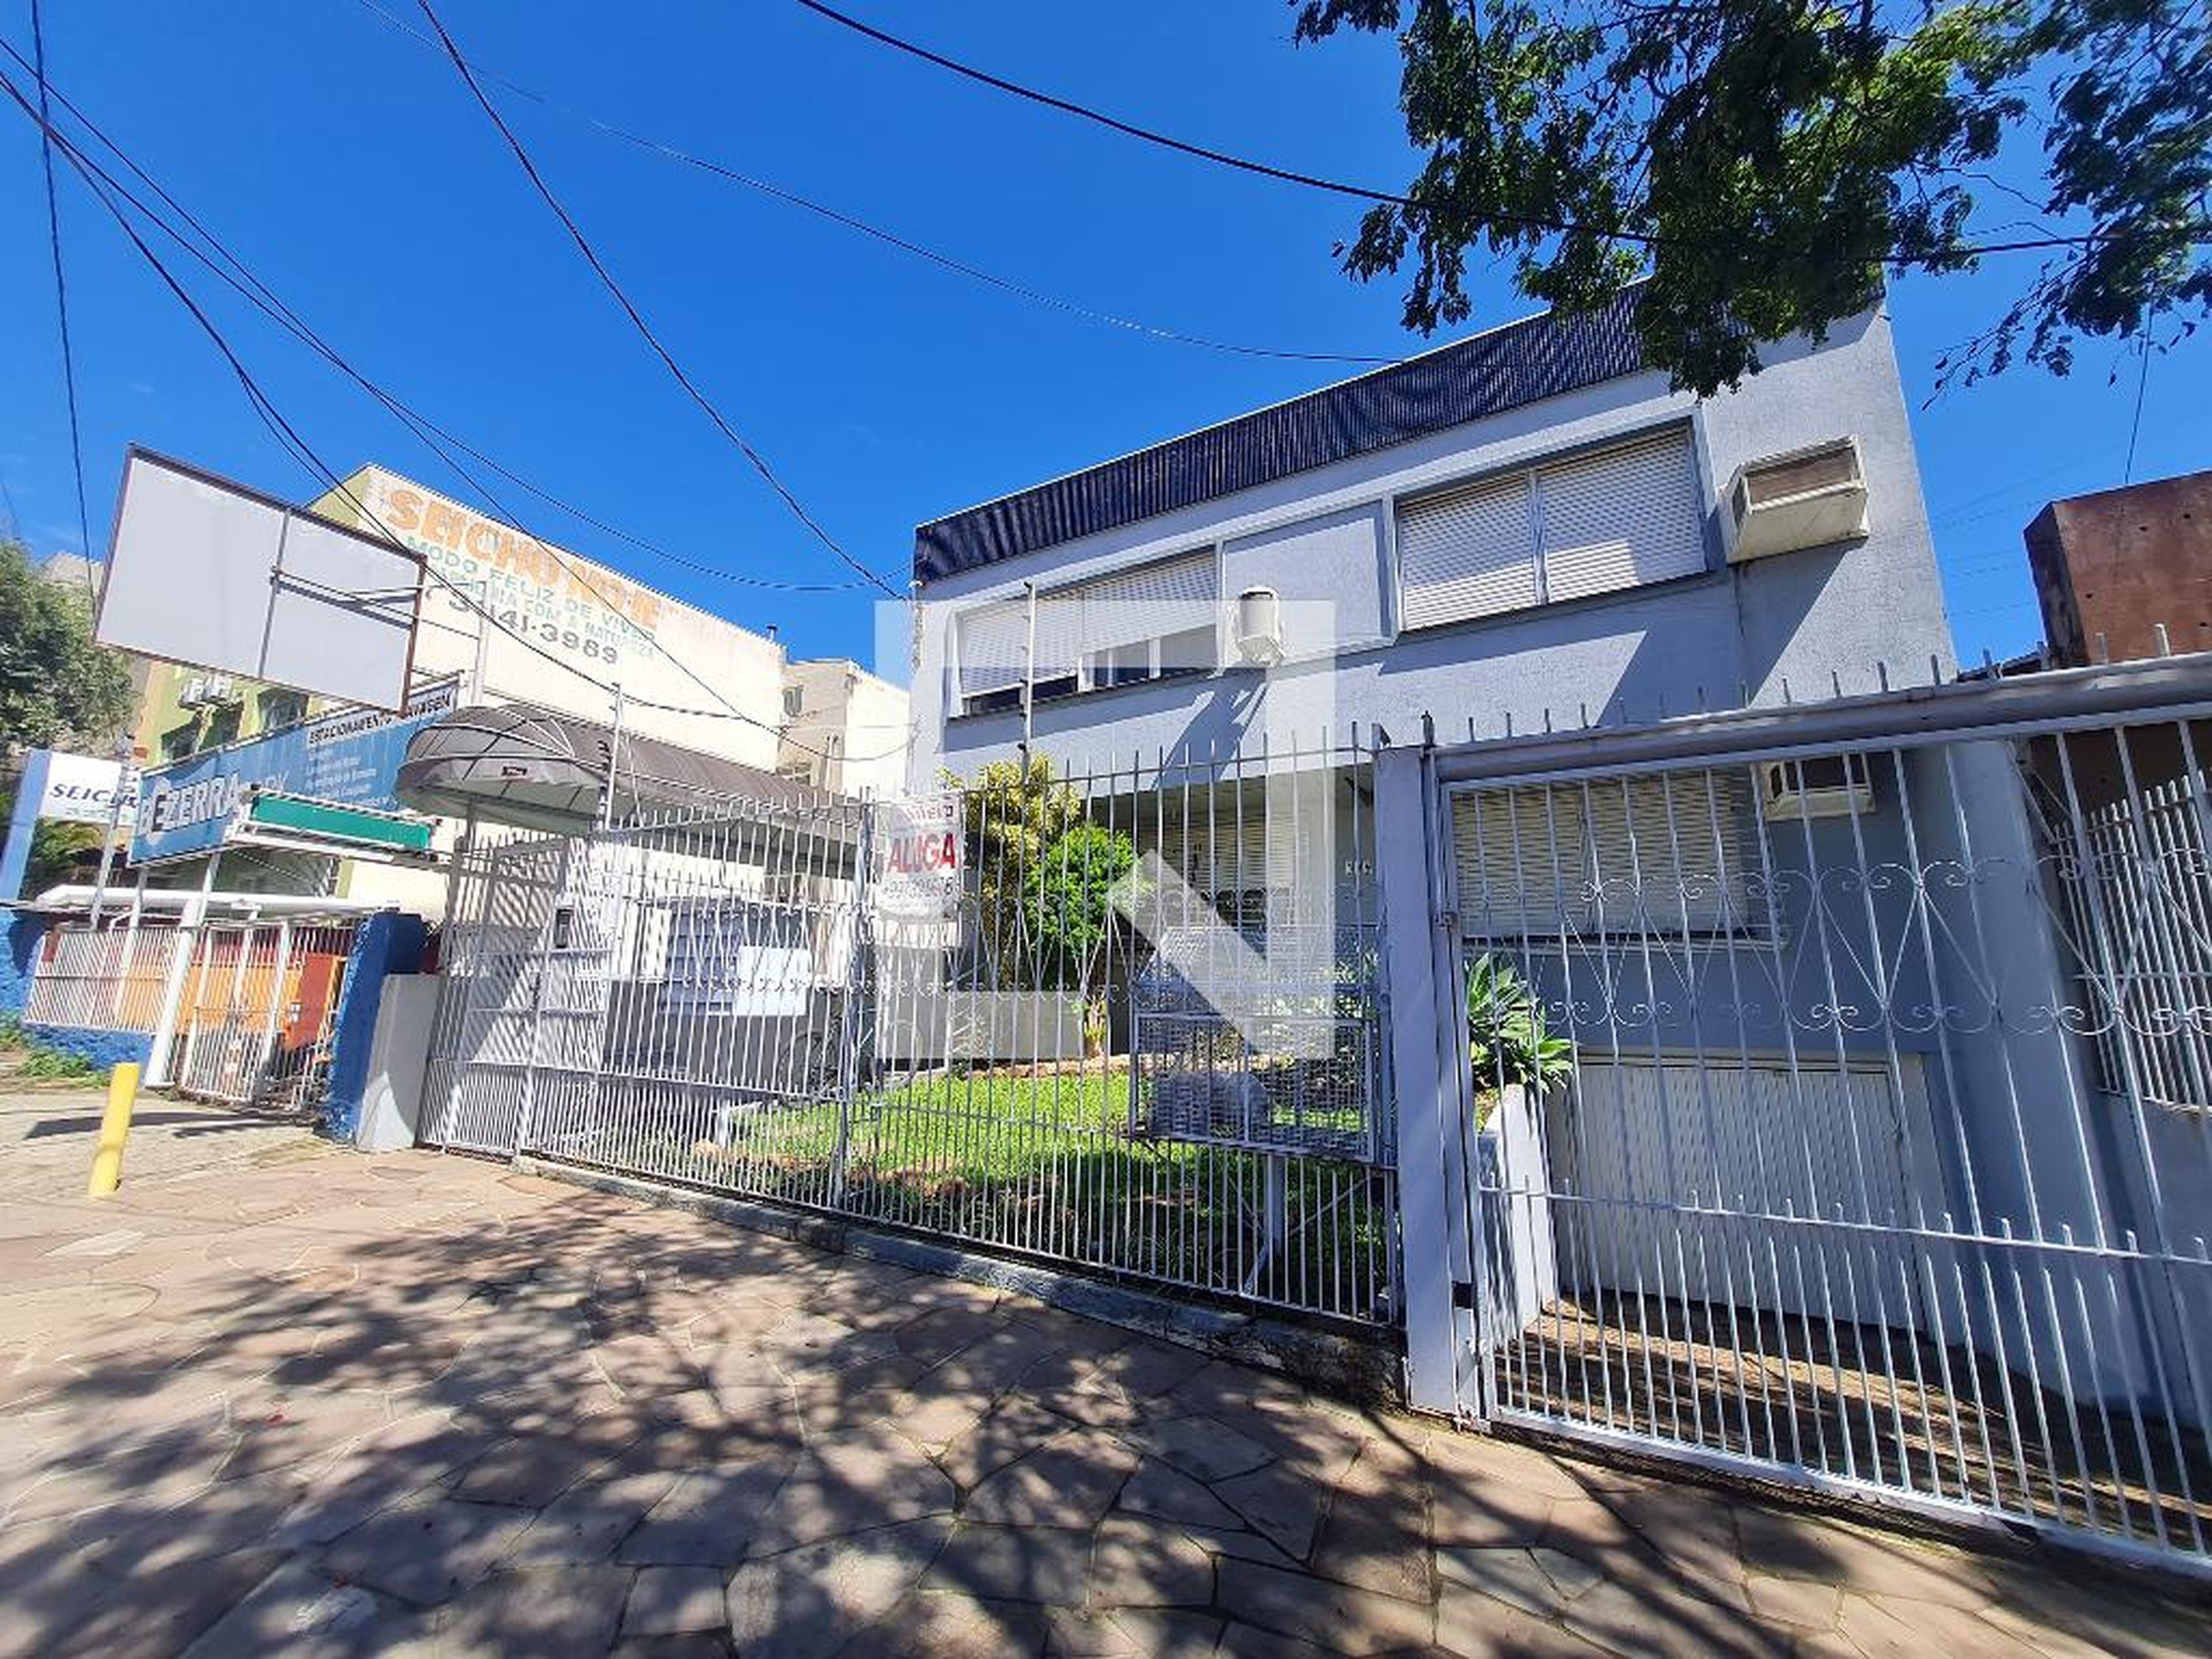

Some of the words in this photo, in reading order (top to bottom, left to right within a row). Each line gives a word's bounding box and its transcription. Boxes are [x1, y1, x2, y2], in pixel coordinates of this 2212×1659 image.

[407, 536, 478, 573] MODO
[489, 568, 554, 604] FELIZ
[887, 833, 956, 874] ALUGA
